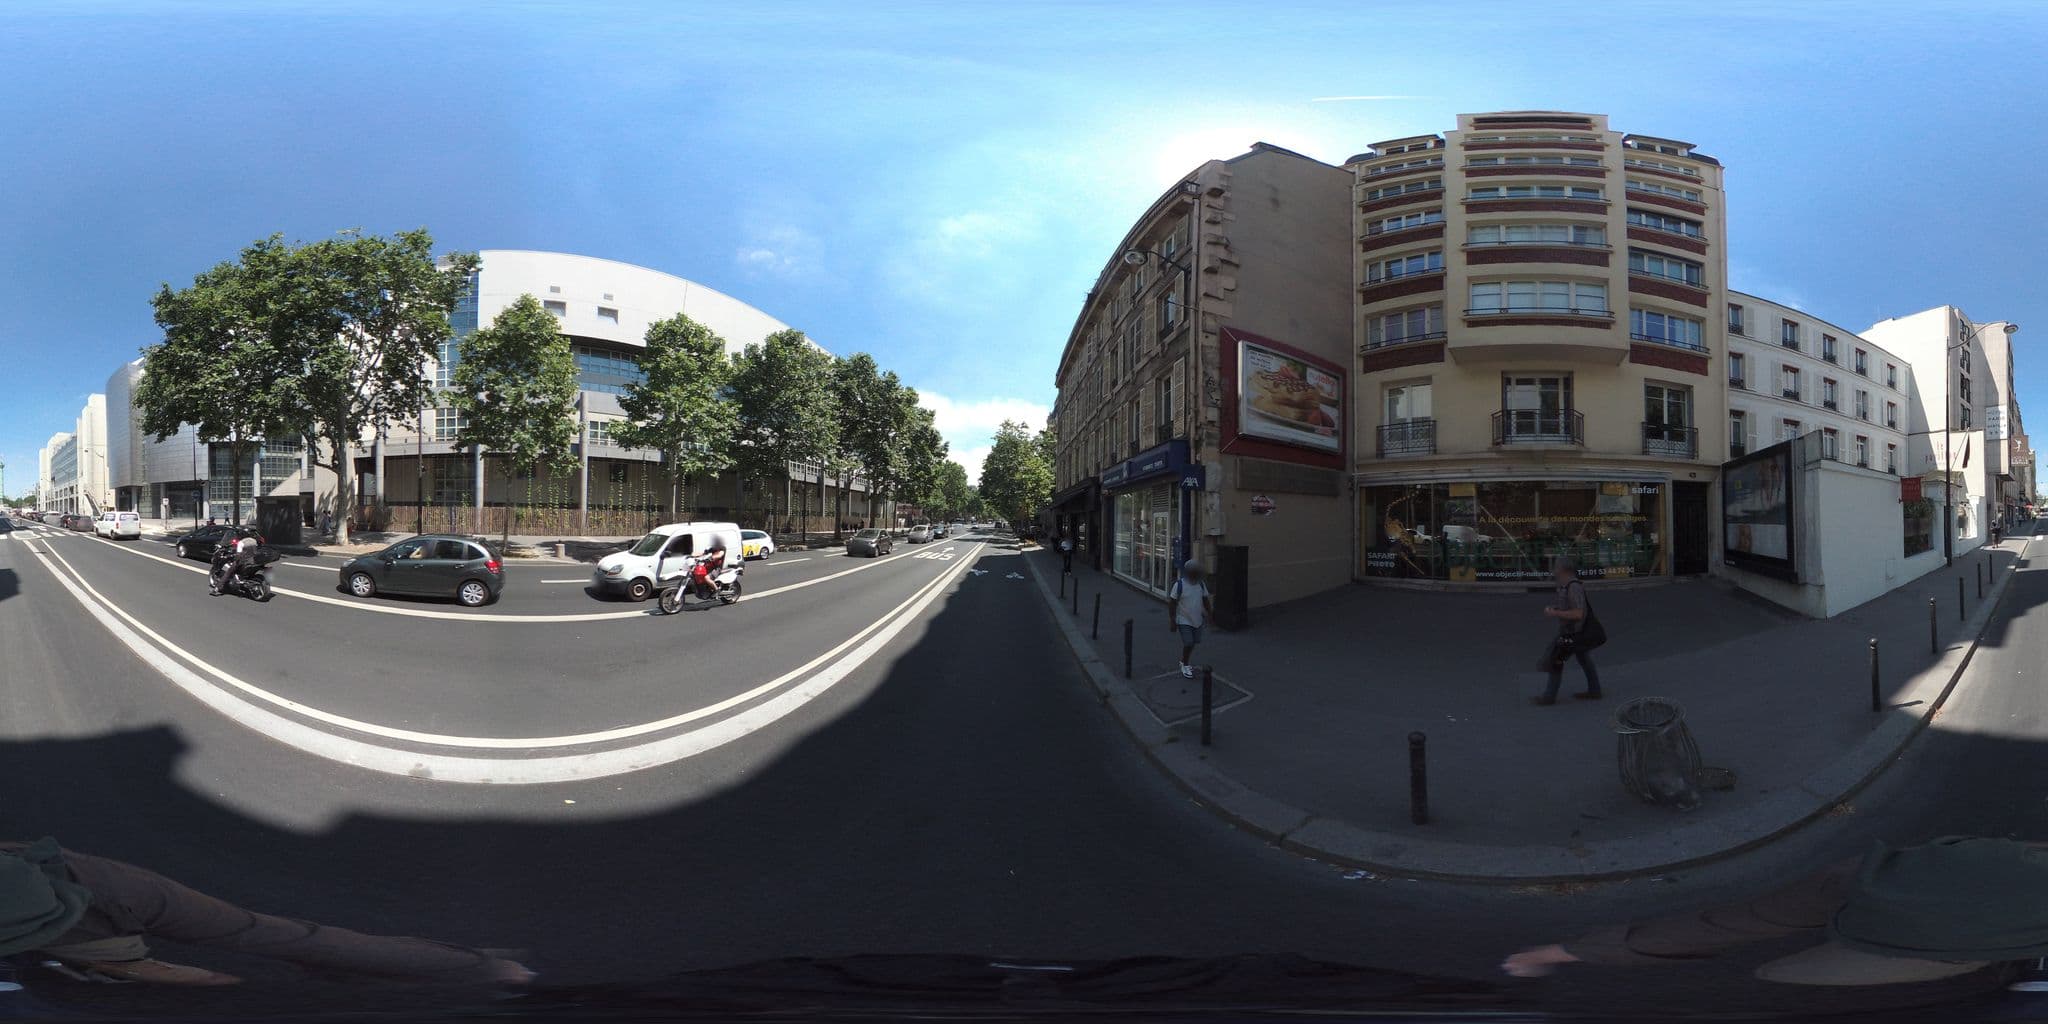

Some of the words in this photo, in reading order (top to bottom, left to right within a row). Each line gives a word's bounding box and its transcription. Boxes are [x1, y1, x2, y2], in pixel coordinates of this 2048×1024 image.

[1181, 477, 1199, 487] AXA
[1631, 485, 1659, 494] safari
[1551, 514, 1567, 522] des
[1569, 514, 1603, 522] mondes
[913, 551, 956, 561] BUS
[1367, 552, 1397, 560] SAFARI
[1367, 560, 1396, 568] PHOTO
